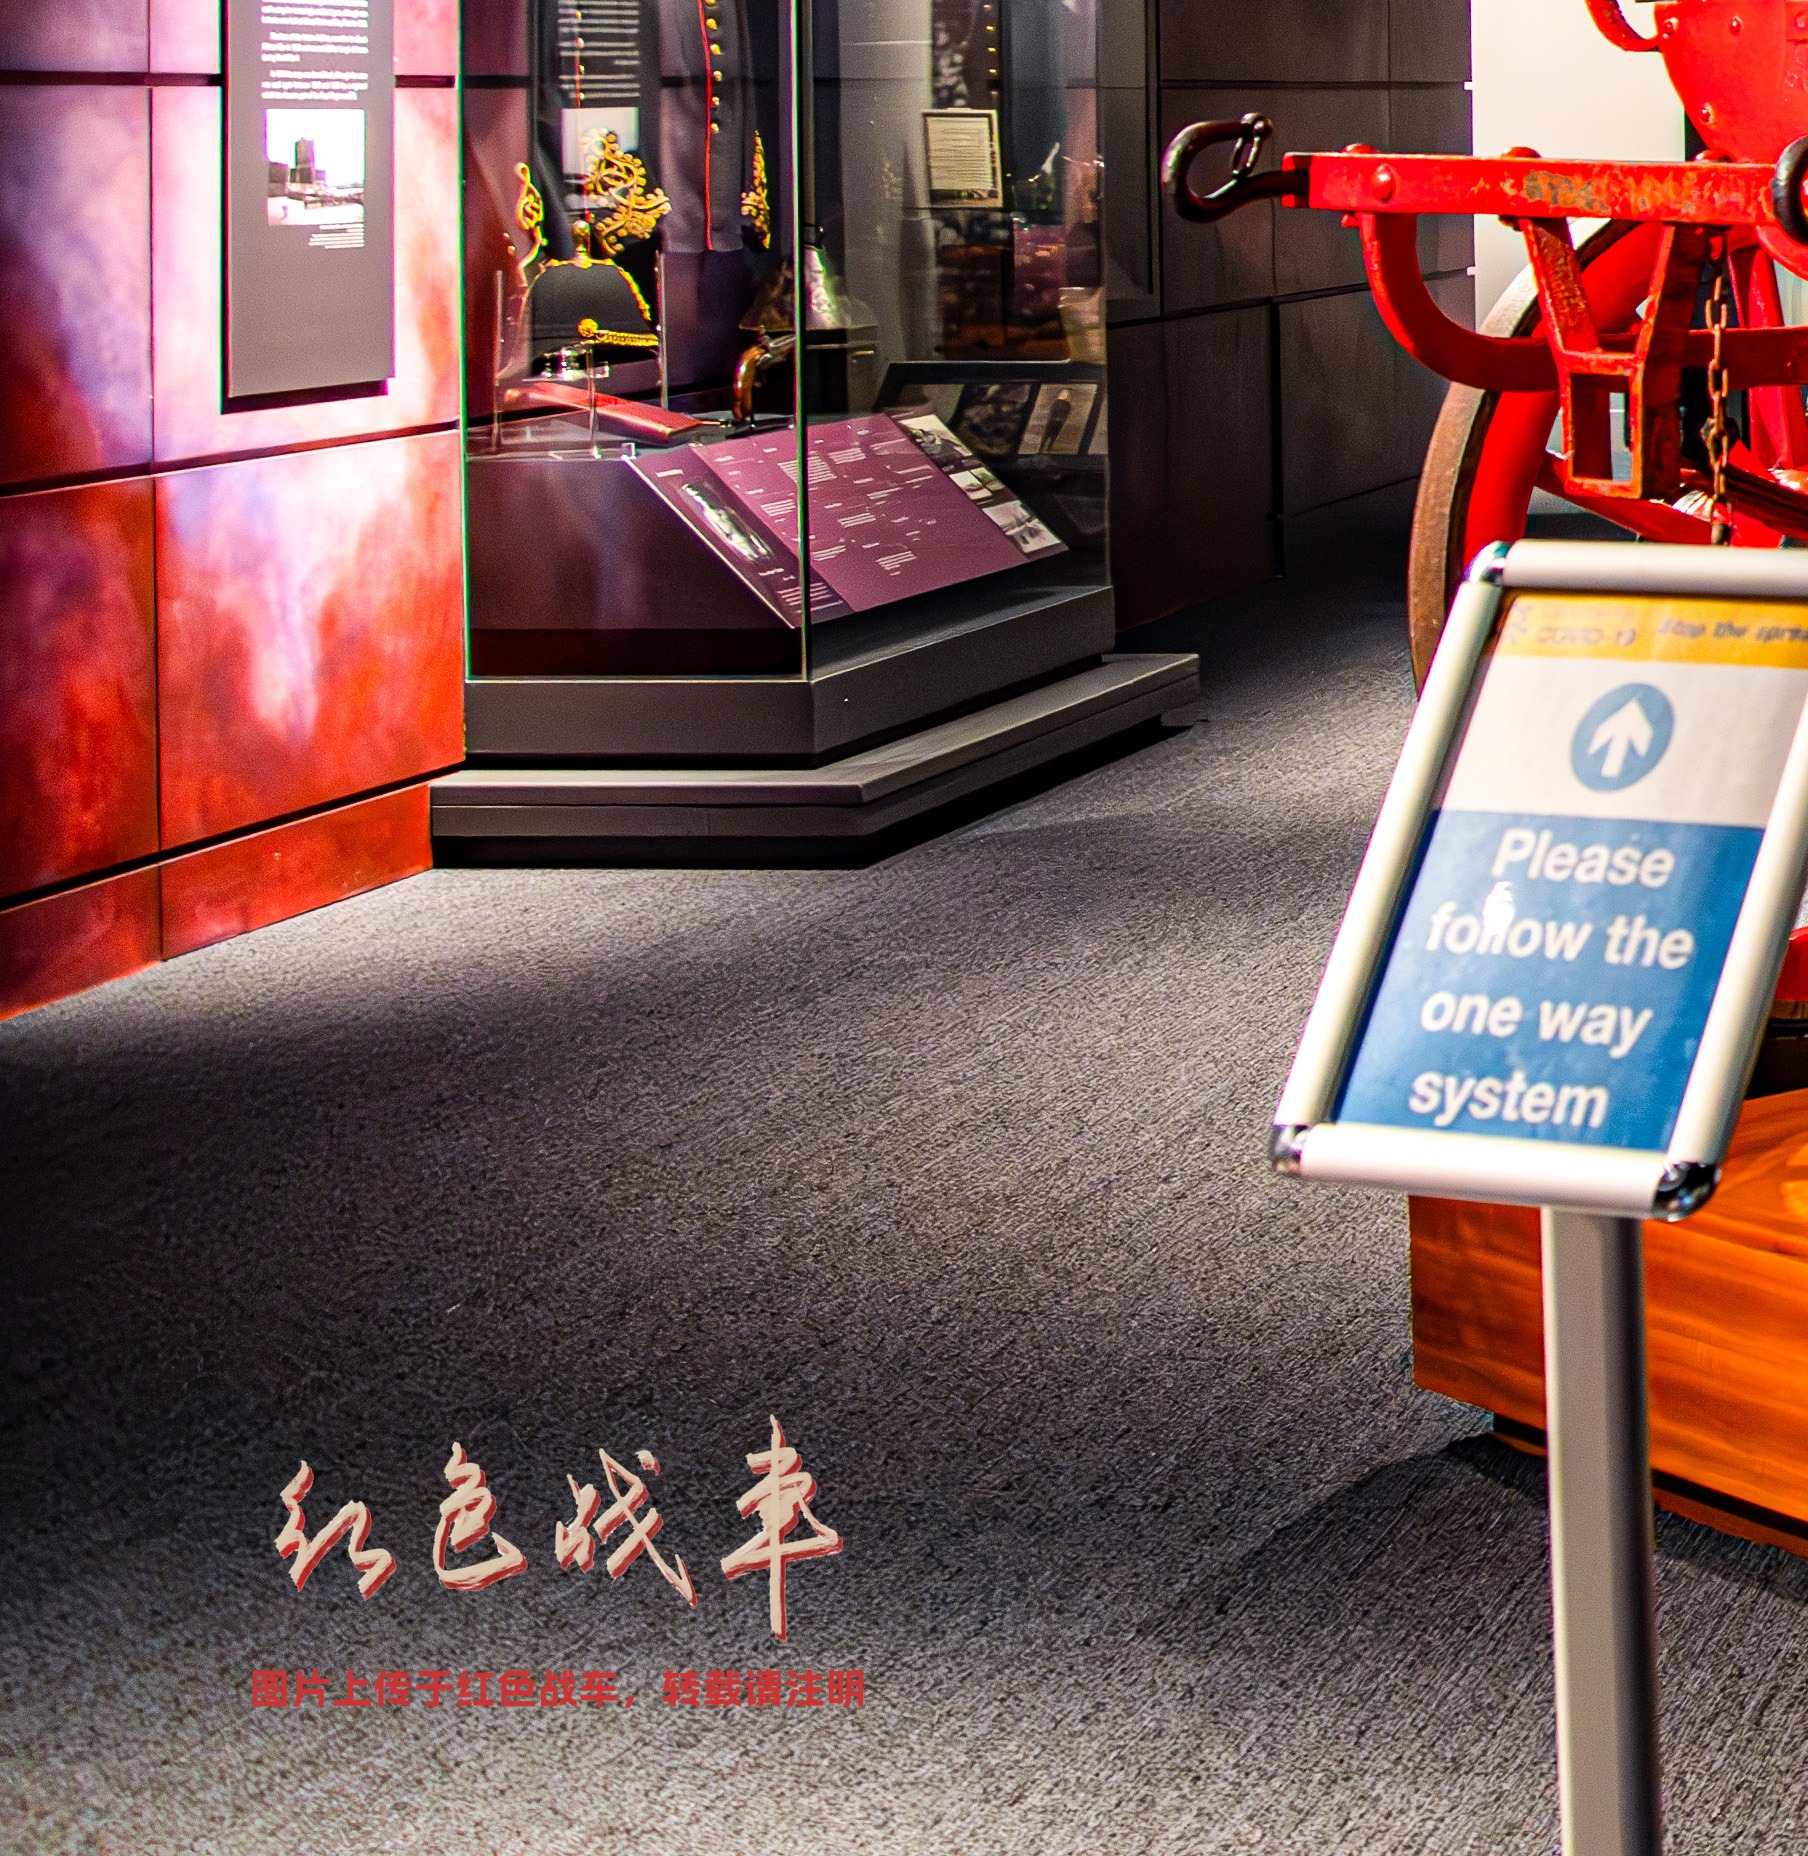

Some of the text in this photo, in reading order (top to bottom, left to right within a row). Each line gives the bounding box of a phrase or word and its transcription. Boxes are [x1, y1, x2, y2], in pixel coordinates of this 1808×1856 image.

[1490, 827, 1676, 888] Please
[1604, 914, 1696, 970] the
[1420, 991, 1654, 1059] one way
[1408, 1069, 1609, 1128] system
